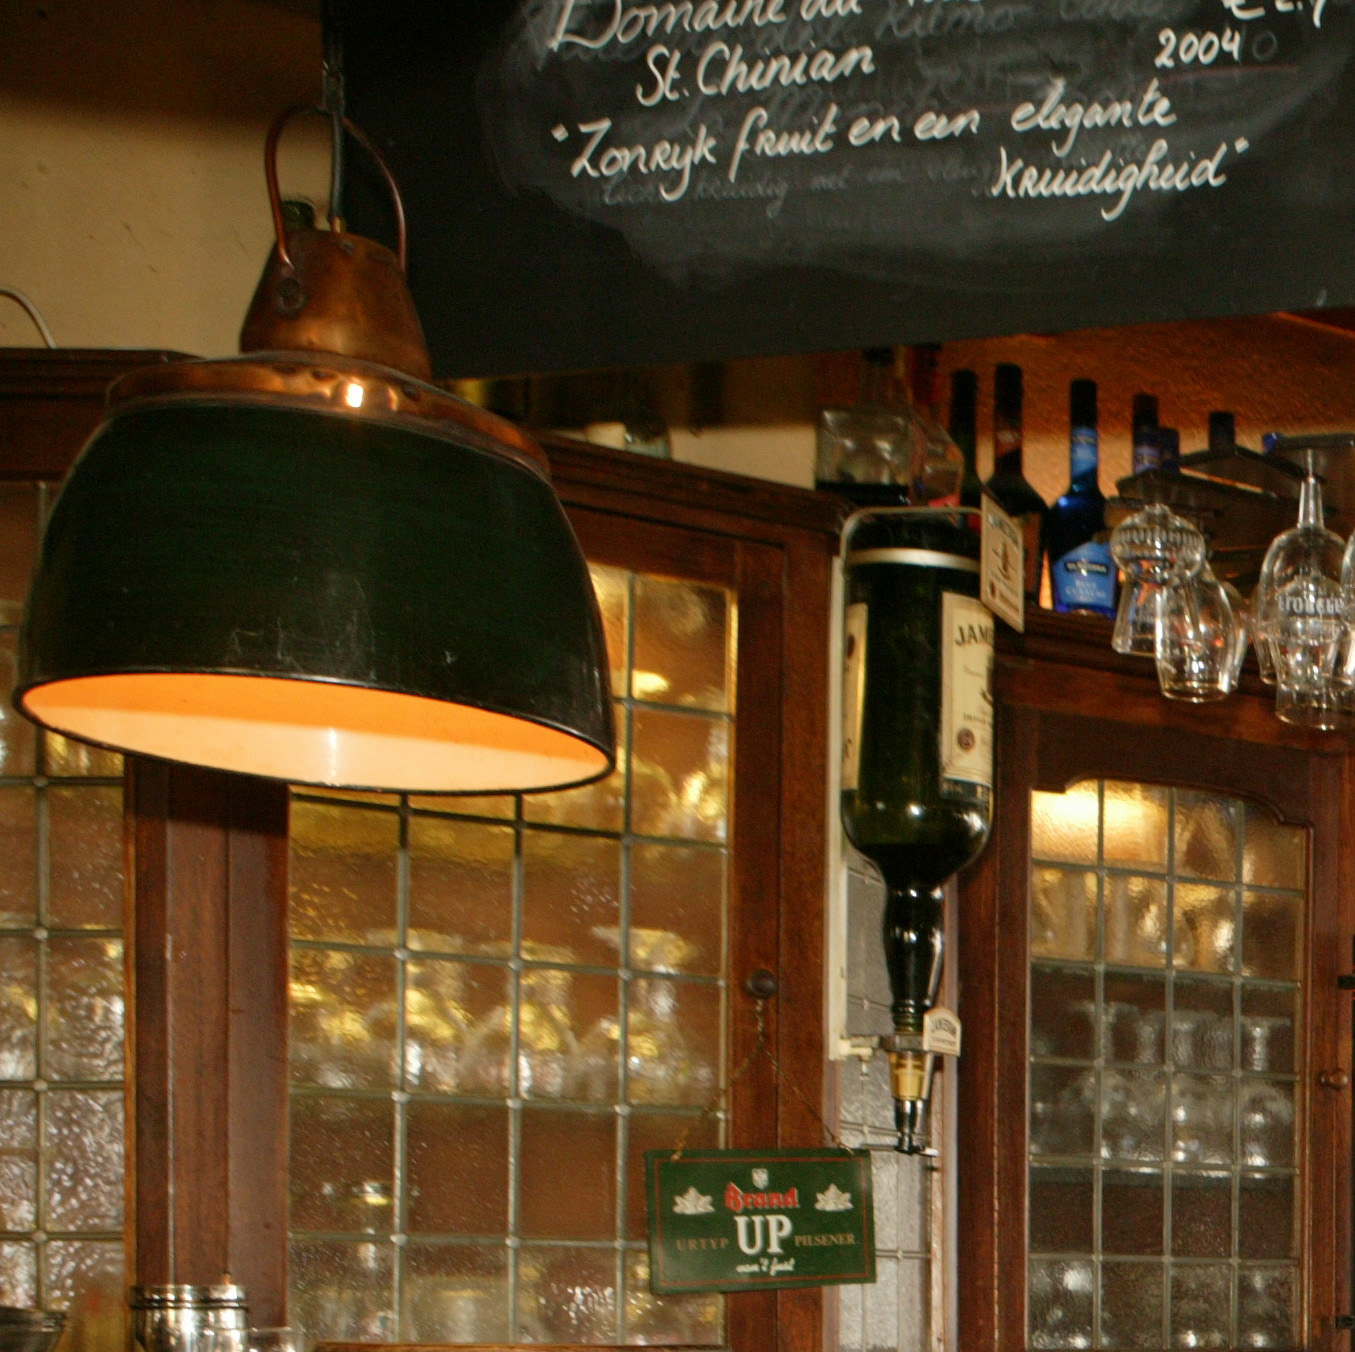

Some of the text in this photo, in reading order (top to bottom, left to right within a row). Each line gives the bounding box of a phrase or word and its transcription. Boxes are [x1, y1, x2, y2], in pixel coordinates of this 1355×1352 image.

[697, 40, 875, 97] Chinian
[1154, 28, 1242, 69] 2004
[728, 103, 838, 184] fruit
[848, 115, 901, 146] en
[914, 109, 980, 140] een
[1011, 77, 1177, 158] elegante
[725, 1182, 801, 1213] Brand
[676, 1233, 857, 1250] URTYP PILSENER
[733, 1214, 793, 1255] UP
